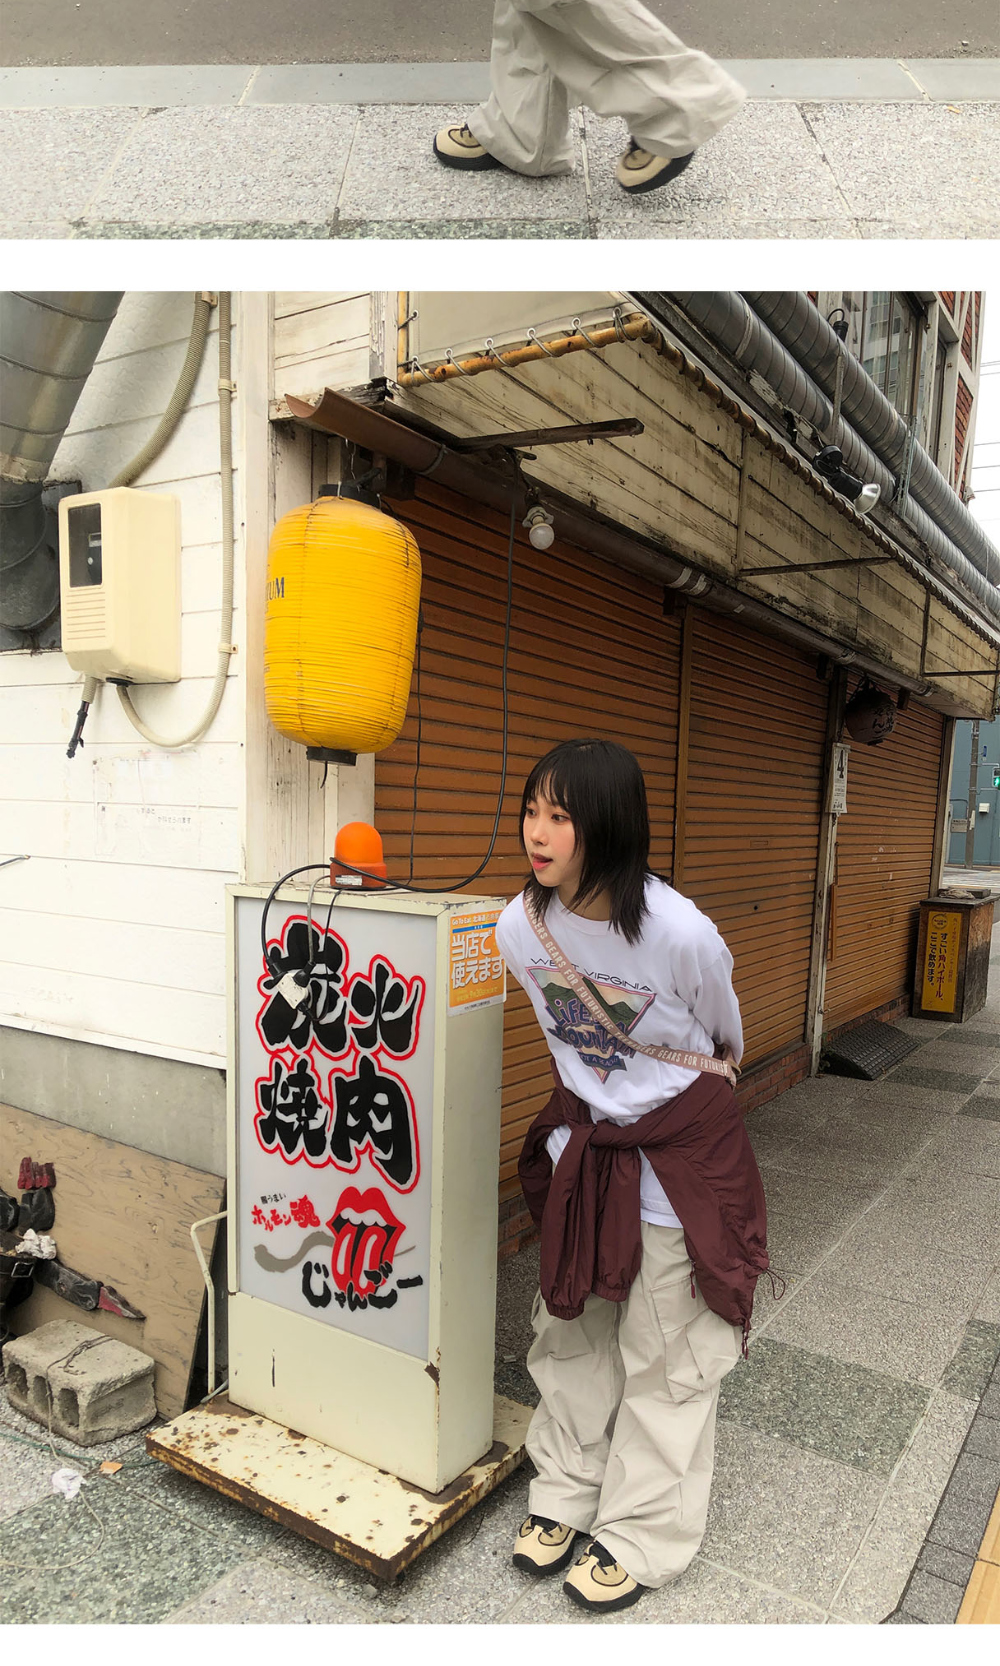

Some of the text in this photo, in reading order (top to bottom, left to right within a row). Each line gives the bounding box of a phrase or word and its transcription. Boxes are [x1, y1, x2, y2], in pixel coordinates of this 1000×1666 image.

[451, 928, 493, 962] 当店で
[257, 916, 425, 1060] 炭火
[451, 956, 504, 990] 使えます
[530, 957, 652, 992] WET VIRGINIA
[545, 941, 567, 968] GEARS
[563, 968, 579, 986] FOR
[576, 986, 614, 1031] FUTURISTIC
[657, 1049, 681, 1062] GEARS
[683, 1054, 698, 1067] FOR
[256, 1055, 420, 1191] 焼肉
[251, 1195, 321, 1232] ホルモン魂
